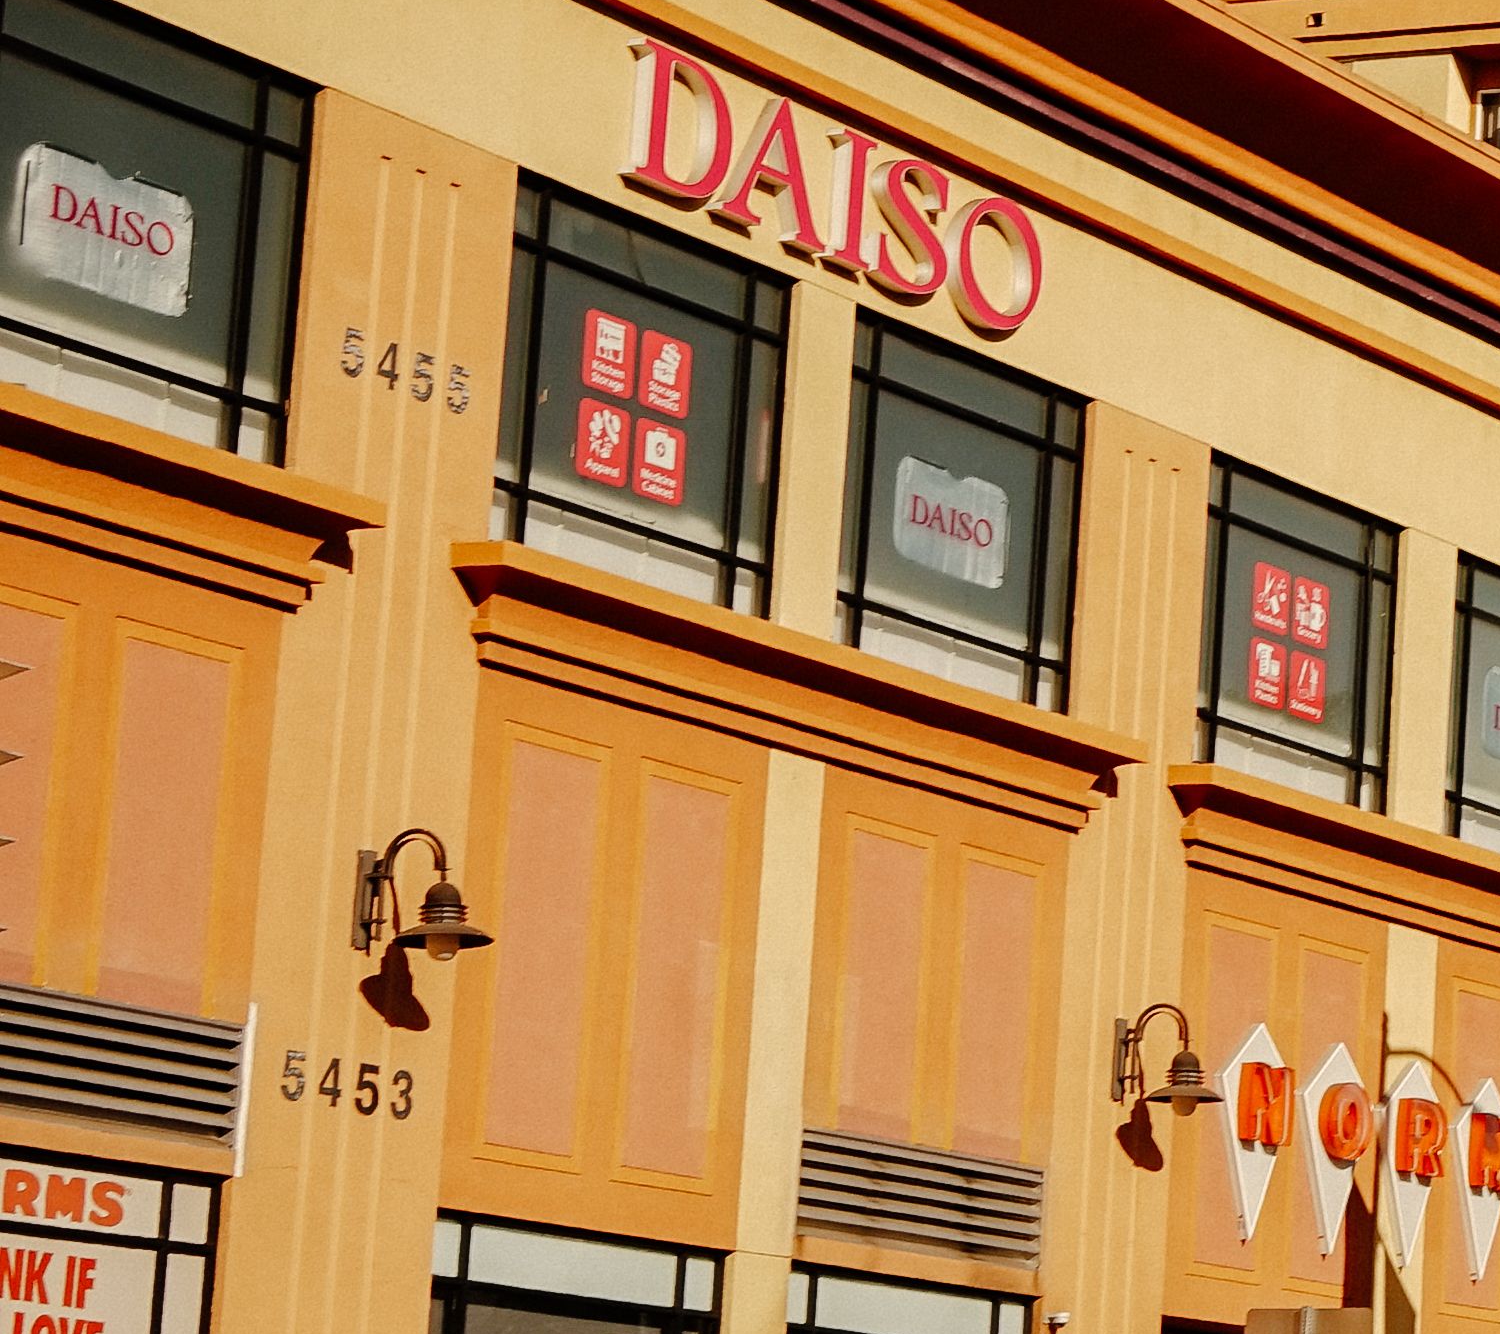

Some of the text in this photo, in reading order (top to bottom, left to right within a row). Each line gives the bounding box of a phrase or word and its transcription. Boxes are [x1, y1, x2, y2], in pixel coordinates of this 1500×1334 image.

[49, 183, 175, 256] DAISO
[618, 37, 1042, 330] DAISO
[340, 327, 471, 415] 5455
[909, 493, 993, 548] DAISO
[280, 1049, 414, 1120] 5453
[62, 1255, 97, 1310] IF
